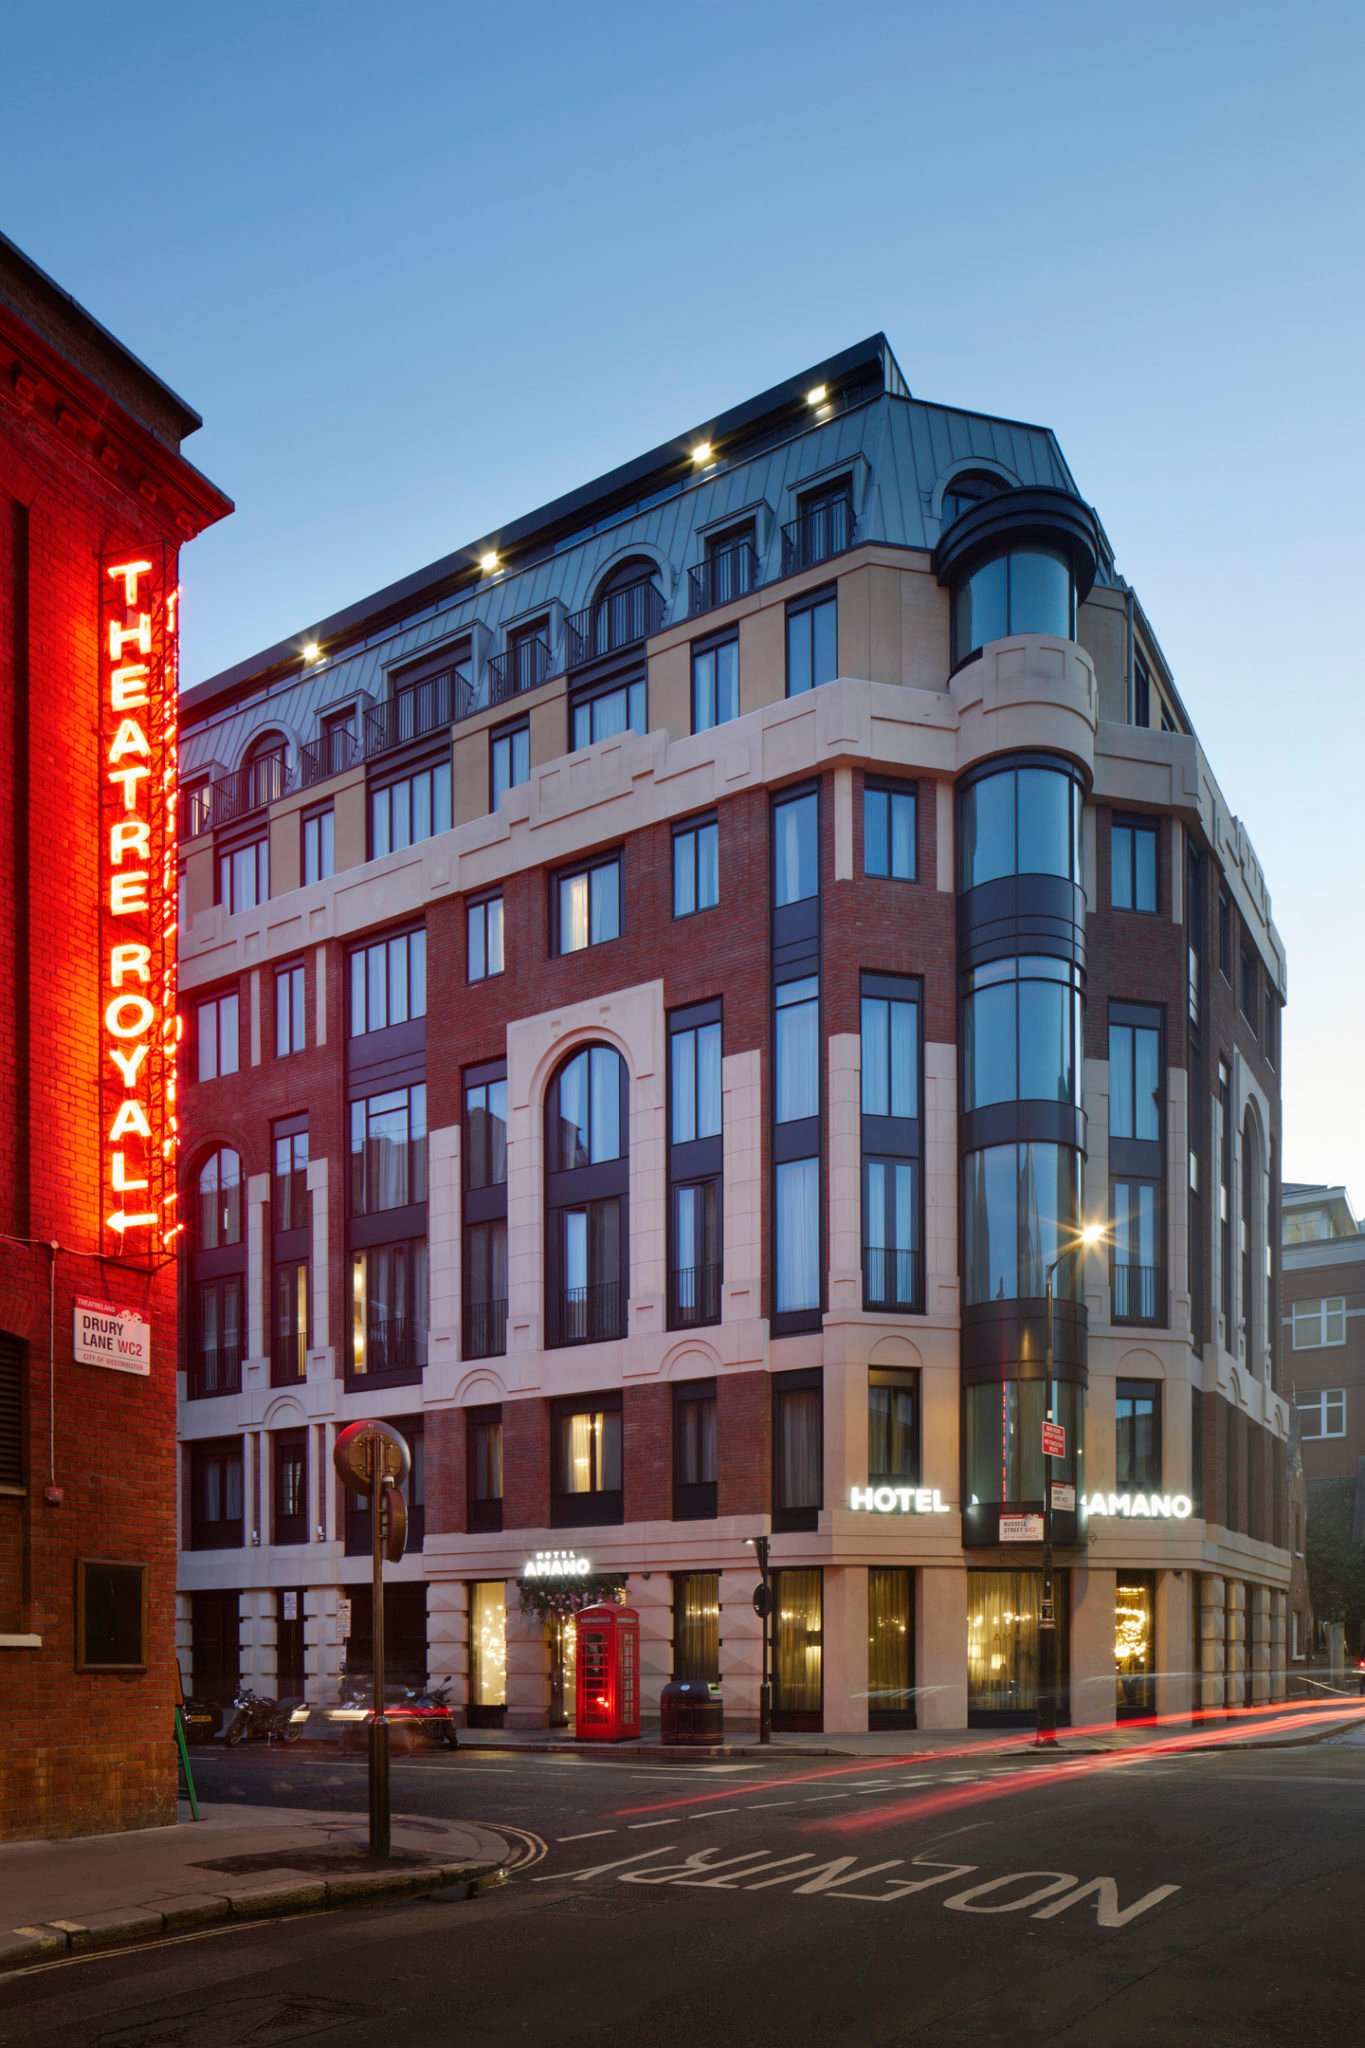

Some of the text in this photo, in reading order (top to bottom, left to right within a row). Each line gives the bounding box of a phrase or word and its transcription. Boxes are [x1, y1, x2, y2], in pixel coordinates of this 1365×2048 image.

[104, 559, 154, 1192] THEATRE ROYAL
[78, 1298, 116, 1313] THEATRELAND
[83, 1315, 124, 1336] DRURY
[83, 1332, 143, 1357] LANE WC2
[83, 1353, 96, 1361] CITY
[106, 1358, 144, 1371] WESTMINSTER
[850, 1486, 951, 1513] HOTEL
[1087, 1492, 1193, 1519] AMANO
[536, 1550, 576, 1560] HOTEL
[524, 1558, 591, 1577] AMANO
[530, 1846, 1182, 1928] NO ENTRY
